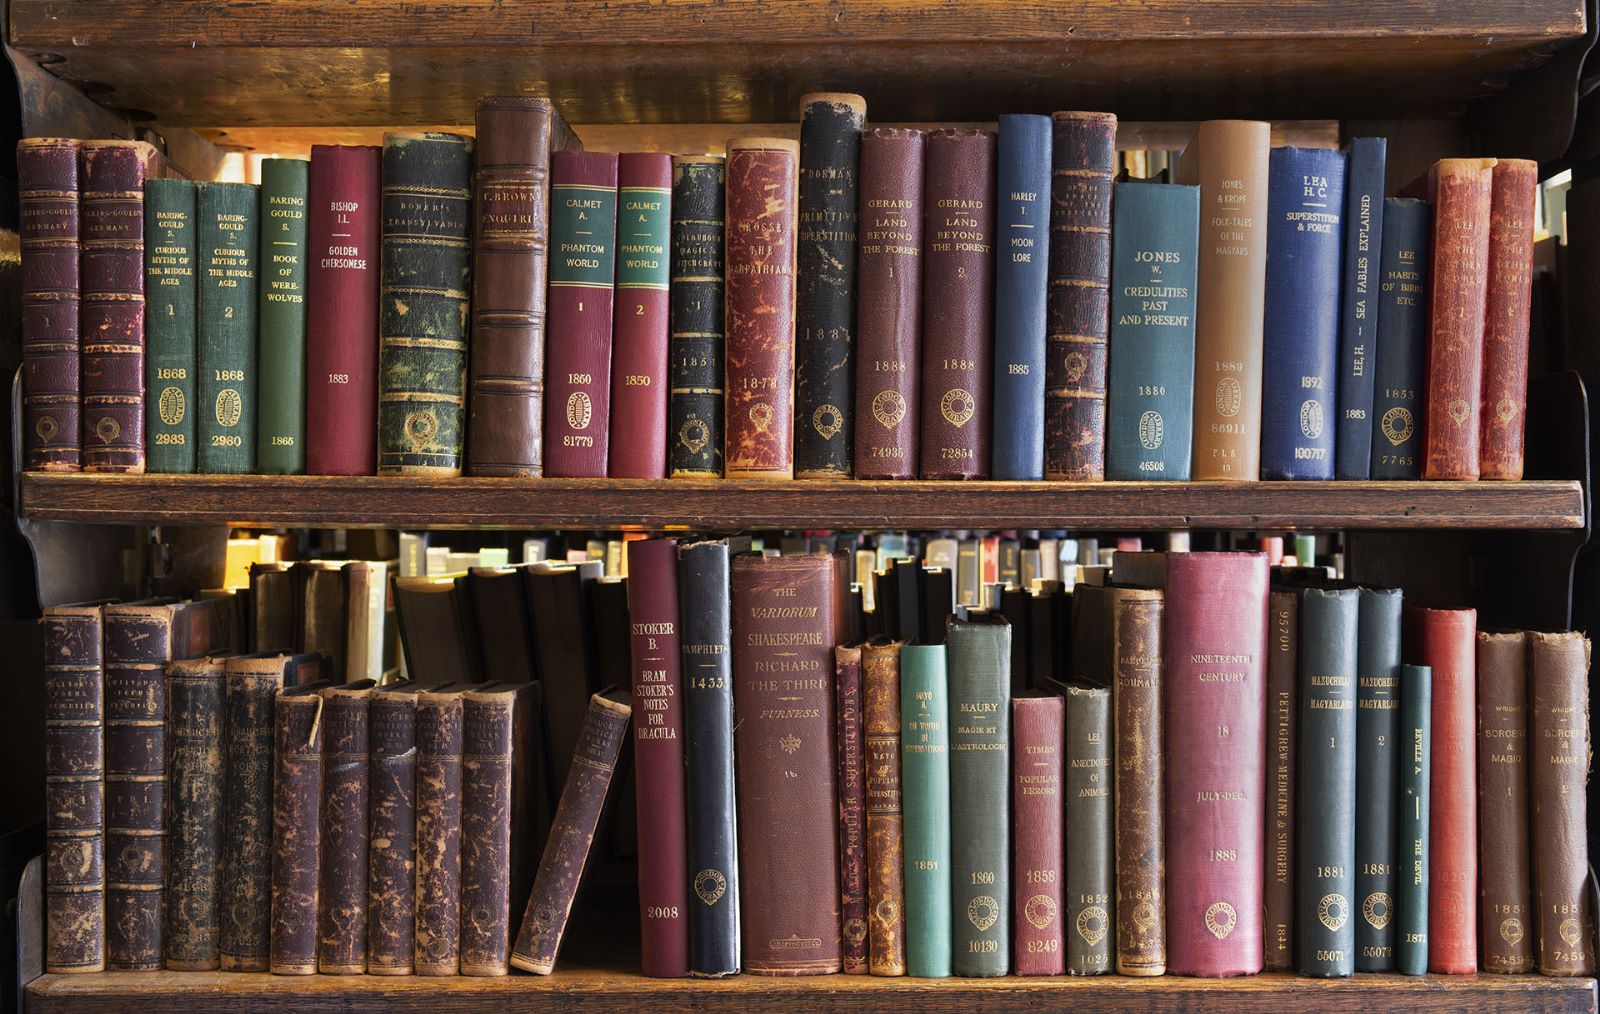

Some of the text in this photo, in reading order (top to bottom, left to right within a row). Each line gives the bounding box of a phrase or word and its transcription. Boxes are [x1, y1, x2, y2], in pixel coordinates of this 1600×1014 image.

[1222, 180, 1243, 189] JONES
[1304, 176, 1328, 187] LEA
[1011, 192, 1037, 201] HARLEY
[1304, 187, 1327, 198] H. C.
[270, 197, 304, 206] BARING
[566, 200, 602, 209] CALMET
[627, 202, 661, 210] CALMET
[868, 200, 913, 209] GERARD
[938, 200, 983, 209] GERARD
[331, 202, 358, 212] BISHOP
[1021, 207, 1028, 215] T.
[218, 214, 248, 222] BARING-
[271, 210, 302, 218] GOULD
[579, 211, 588, 220] A.
[638, 214, 647, 222] A.
[1286, 211, 1339, 224] SUPERSTITION
[388, 218, 464, 229] TRANSYLVANIA
[876, 219, 907, 228] LAND
[946, 218, 977, 227] LAND
[1212, 218, 1252, 227] FOLK-TALES
[1297, 223, 1331, 234] & FORCE
[868, 231, 912, 241] BEYOND
[937, 231, 983, 241] BEYOND
[1221, 232, 1245, 240] OF THE
[932, 243, 991, 253] THE FOREST
[1011, 239, 1034, 247] MOON
[214, 249, 246, 257] CURIOUS
[329, 246, 358, 256] GOLDEN
[561, 243, 604, 254] PHANTOM
[622, 245, 663, 254] PHANTOM
[750, 246, 773, 255] THE
[863, 245, 920, 256] THE FOREST
[1216, 247, 1248, 256] MAGYARS
[273, 255, 297, 263] BOOK
[1013, 253, 1031, 263] LORE
[1135, 252, 1180, 263] JONES
[1399, 251, 1415, 259] LEE
[212, 257, 236, 265] MYTHS
[322, 259, 366, 270] CHERSONESE
[567, 259, 599, 269] WORLD
[627, 260, 658, 269] WORLD
[279, 268, 292, 276] OF
[889, 268, 894, 277] 1
[958, 267, 966, 278] 2
[1151, 265, 1162, 274] W.
[1353, 195, 1371, 376] LEE, H. SEA FABLES EXPLAINED
[1382, 283, 1395, 291] OF
[1124, 288, 1188, 297] CREDULITIES
[268, 293, 303, 303] WOLVES
[1397, 297, 1416, 306] ETC.
[168, 305, 175, 316] 1
[579, 303, 583, 311] 1
[636, 305, 644, 315] 2
[1142, 301, 1168, 311] PAST
[224, 306, 234, 318] 2
[1120, 315, 1189, 326] AND PRESENT
[875, 360, 907, 371] 1888
[943, 359, 975, 371] 1888
[1008, 364, 1030, 375] 1885
[157, 368, 187, 379] 1868
[215, 370, 245, 381] 1868
[328, 374, 349, 384] 1883
[625, 375, 651, 385] 1850
[1302, 377, 1324, 389] 1892
[1139, 386, 1165, 396] 1880
[1345, 409, 1365, 419] 1883
[211, 435, 242, 447] 2980
[272, 437, 294, 446] 1865
[563, 435, 593, 447] 81779
[942, 449, 973, 459] 72854
[1140, 462, 1164, 471] 46508
[773, 588, 796, 597] THE
[751, 608, 818, 618] VARIORUM
[632, 623, 674, 634] STOKER
[1279, 611, 1290, 652] 95700
[649, 638, 658, 649] B.
[748, 633, 823, 646] SHAKESPEARE
[1191, 655, 1251, 663] NINETEENTH
[755, 661, 819, 671] RICHARD
[642, 671, 666, 681] BRAM
[1200, 673, 1246, 681] CENTURY
[637, 685, 674, 696] STOKER'S
[750, 680, 828, 691] THE THIRD
[644, 699, 668, 709] NOTES
[960, 704, 998, 713] MAURY
[648, 714, 663, 724] FOR
[760, 710, 821, 719] FURNESS.
[638, 728, 676, 739] DRACULA
[1218, 726, 1229, 737] 18
[1088, 734, 1101, 742] LEE
[1330, 738, 1335, 748] 1
[1378, 736, 1385, 746] 2
[1491, 755, 1521, 763] MAGIC
[1508, 787, 1511, 796] 1
[1561, 785, 1568, 794] 2
[1210, 850, 1237, 861] 1885
[1276, 832, 1288, 884] SURGERY
[1318, 867, 1345, 877] 1881
[1364, 864, 1390, 874] 1881
[971, 872, 994, 884] 1860
[1027, 871, 1055, 882] 1858
[1081, 894, 1108, 904] 1852
[647, 907, 679, 918] 2008
[1277, 924, 1286, 950] 1844
[969, 941, 997, 952] 10130
[1029, 940, 1057, 952] 8249
[1081, 955, 1108, 964] 1025
[1318, 950, 1344, 961] 55071
